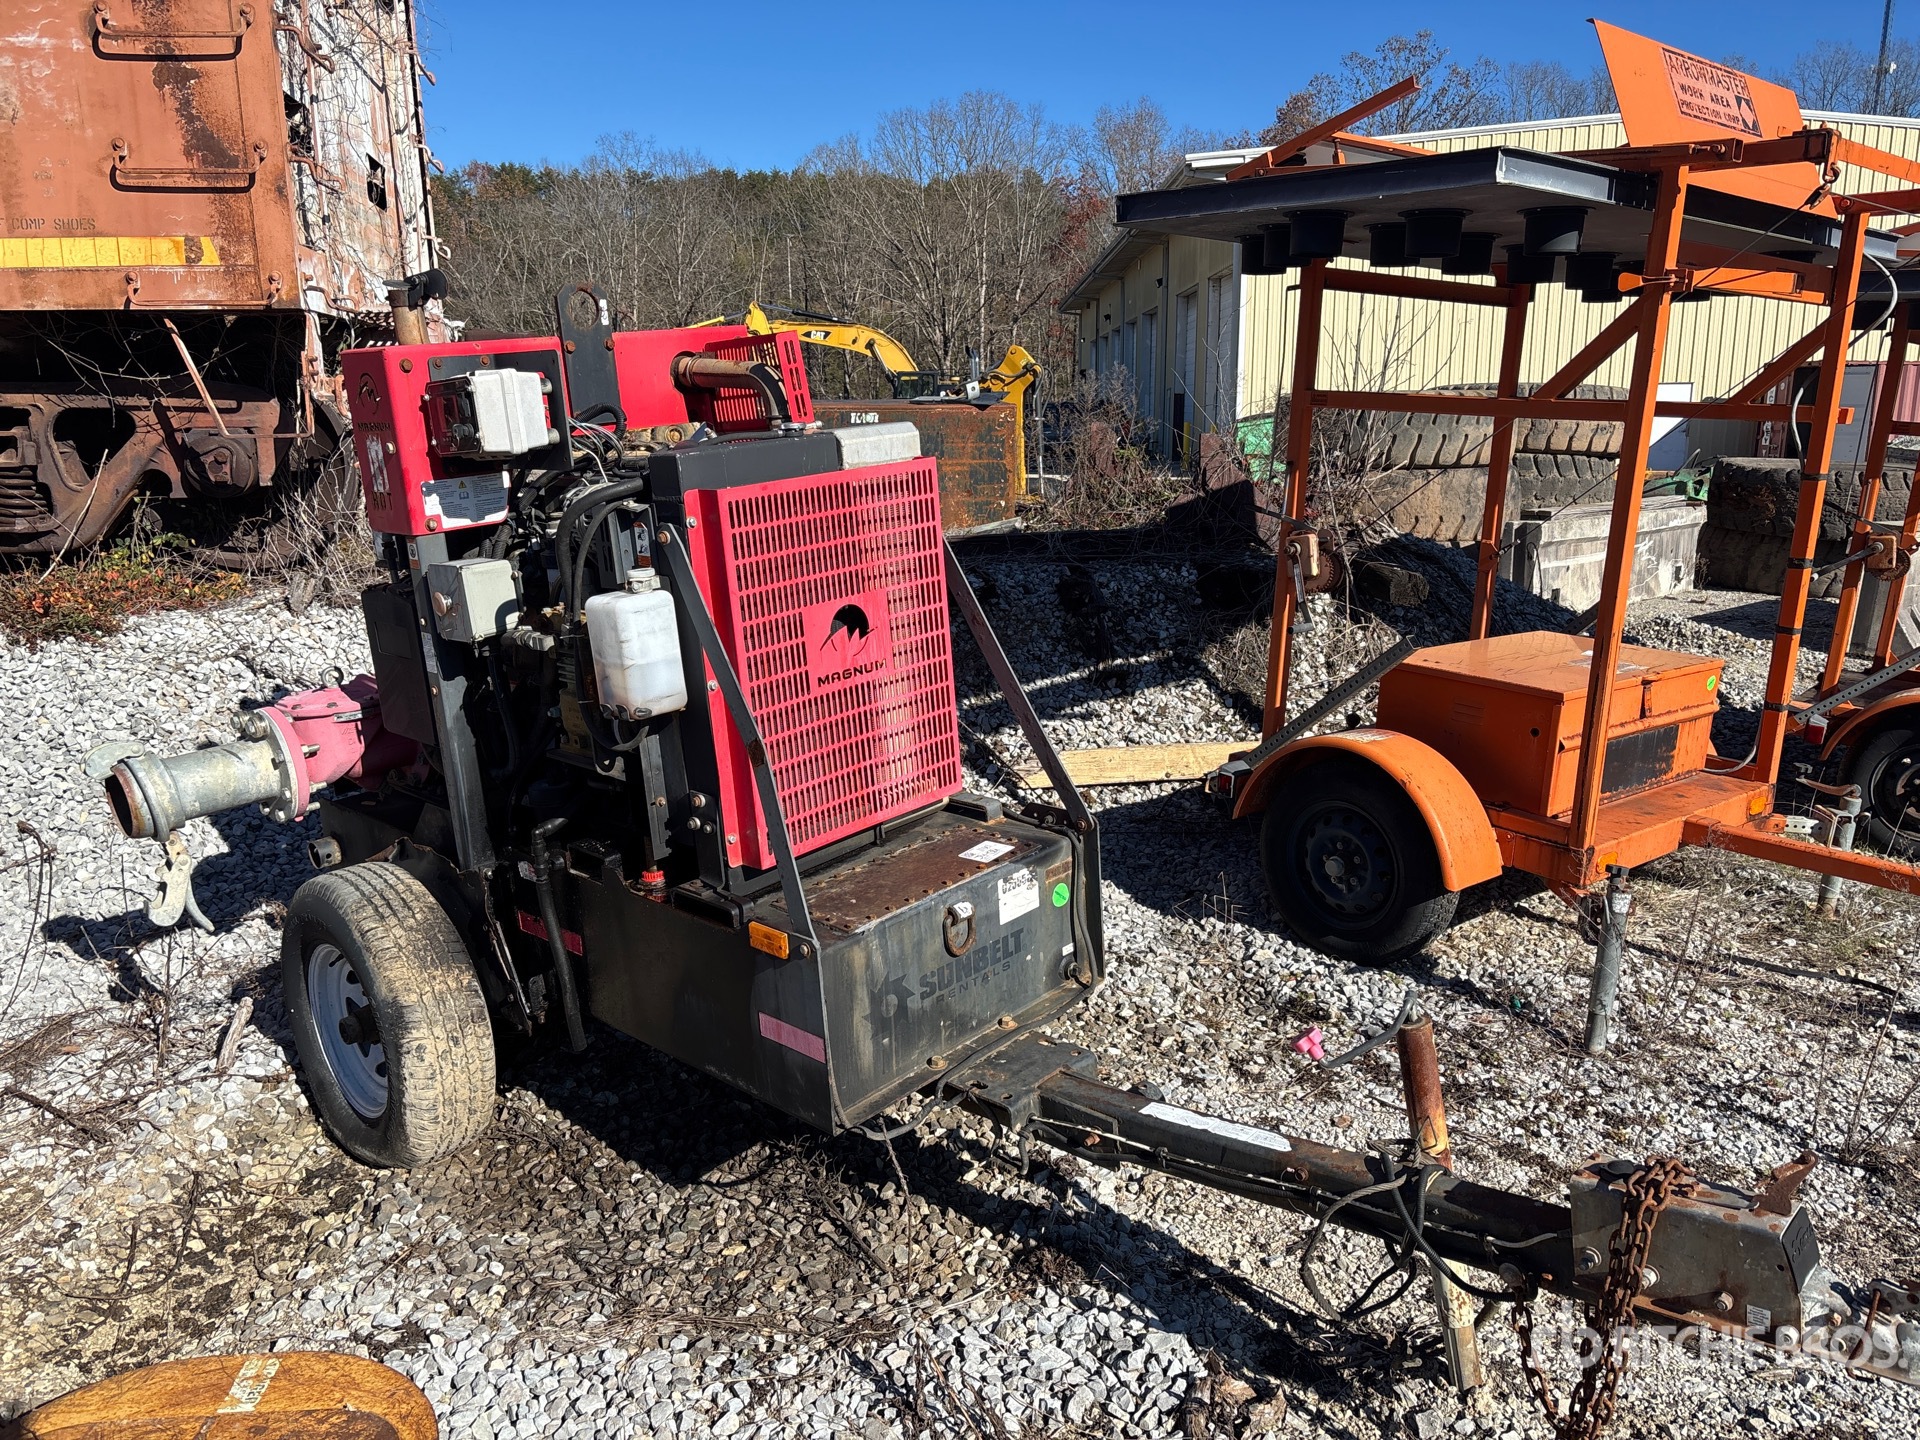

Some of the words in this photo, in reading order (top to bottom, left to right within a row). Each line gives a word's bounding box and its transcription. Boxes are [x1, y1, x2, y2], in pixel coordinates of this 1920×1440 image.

[1668, 54, 1749, 98] ARROWMASTER
[1679, 82, 1704, 101] WORK
[1709, 92, 1732, 110] AREA
[1680, 100, 1722, 121] PROTECTION
[12, 218, 46, 230] COMP
[53, 218, 96, 231] SHOES
[811, 330, 826, 340] CAT
[357, 422, 391, 432] MAGNUM
[817, 658, 887, 688] MAGNUM
[919, 928, 1025, 1001] SUNBELT
[935, 961, 1012, 1004] RENTALS
